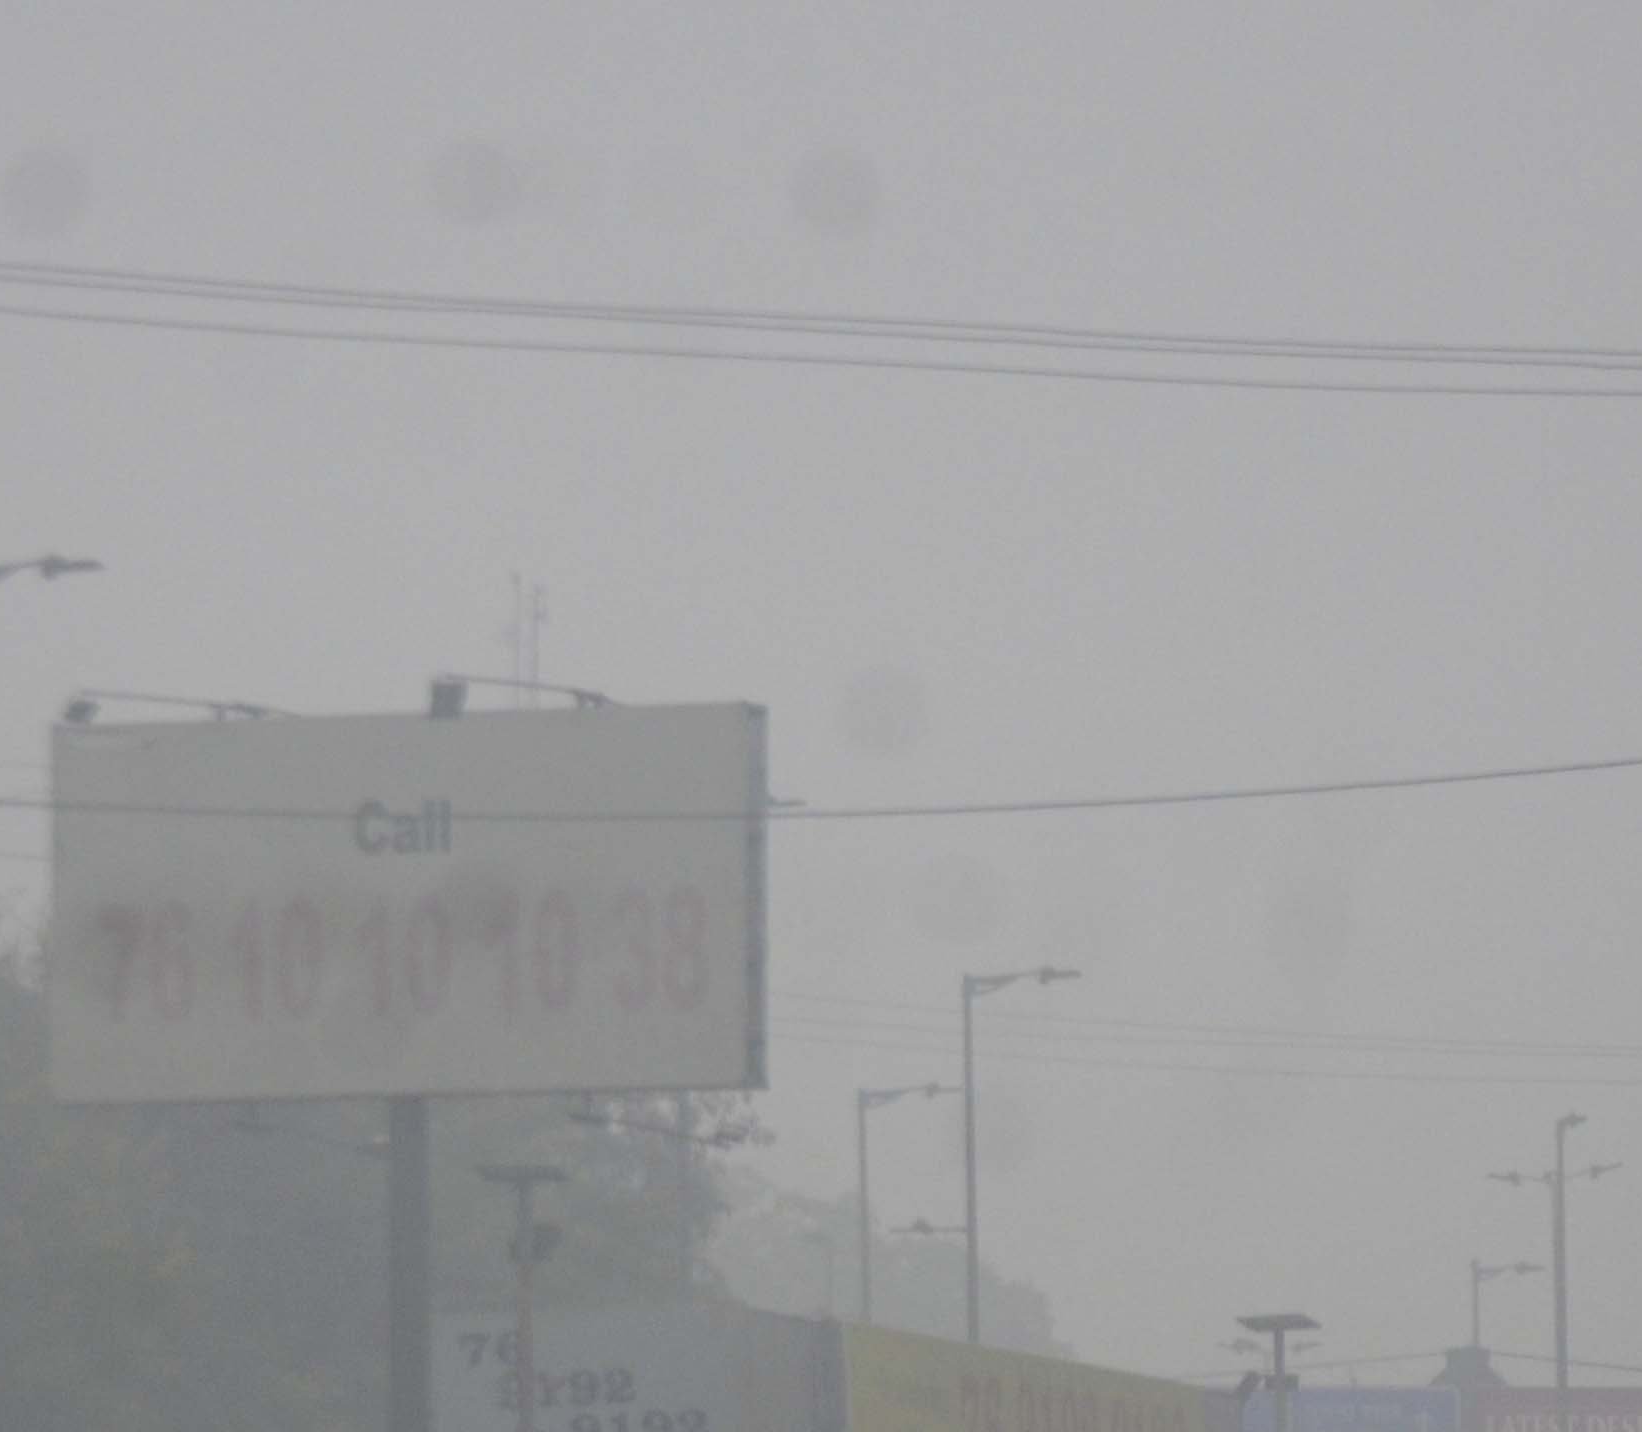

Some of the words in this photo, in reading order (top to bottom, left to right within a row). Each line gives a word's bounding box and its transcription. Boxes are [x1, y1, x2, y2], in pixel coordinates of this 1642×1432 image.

[356, 799, 452, 855] Call
[355, 893, 453, 1017] 10
[611, 883, 710, 1013] 38
